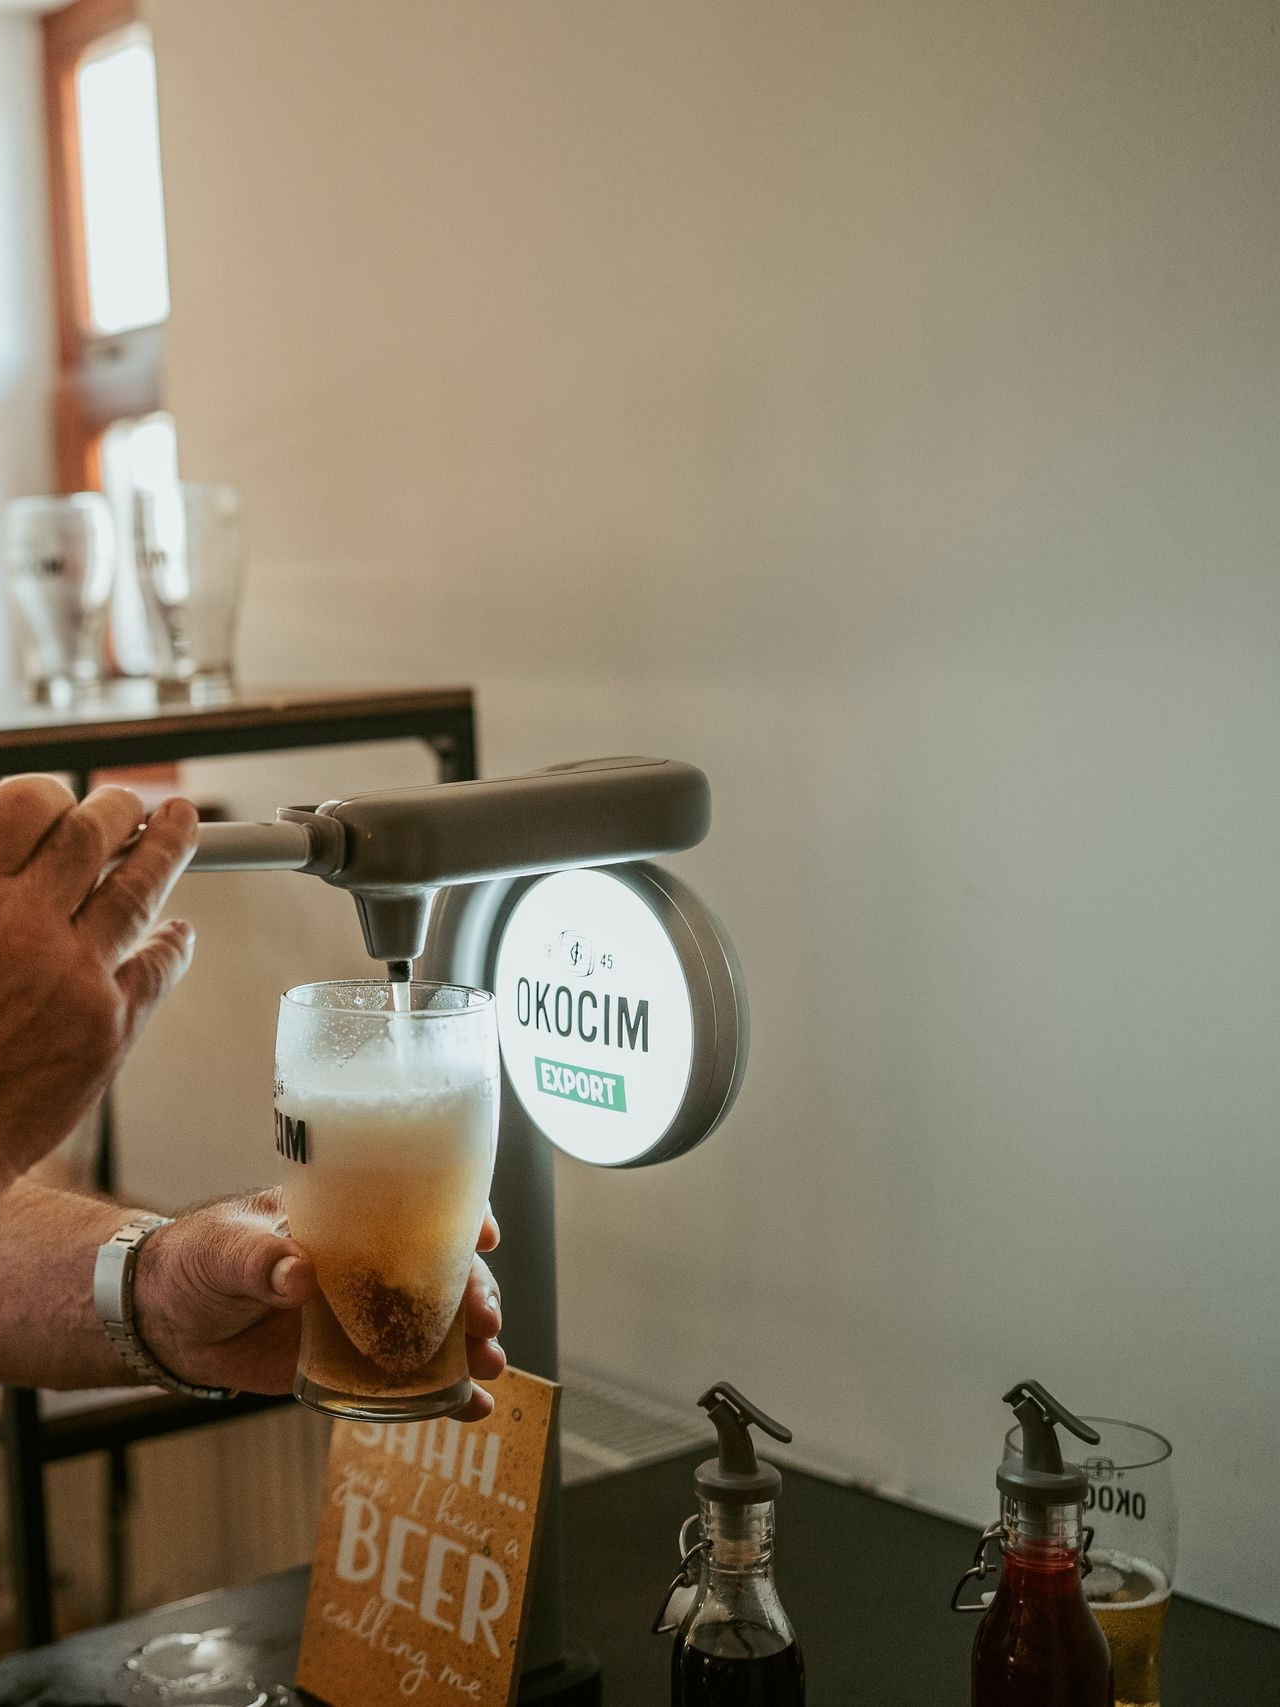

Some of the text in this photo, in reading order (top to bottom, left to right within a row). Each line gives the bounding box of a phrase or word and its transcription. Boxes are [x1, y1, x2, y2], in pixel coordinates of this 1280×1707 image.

[517, 977, 649, 1053] OKOCIM
[540, 1062, 616, 1106] EXPORT
[409, 1471, 429, 1515] I
[434, 1483, 497, 1542] hear
[504, 1538, 520, 1560] a
[335, 1490, 510, 1659] BEER
[322, 1595, 482, 1701] calling me
